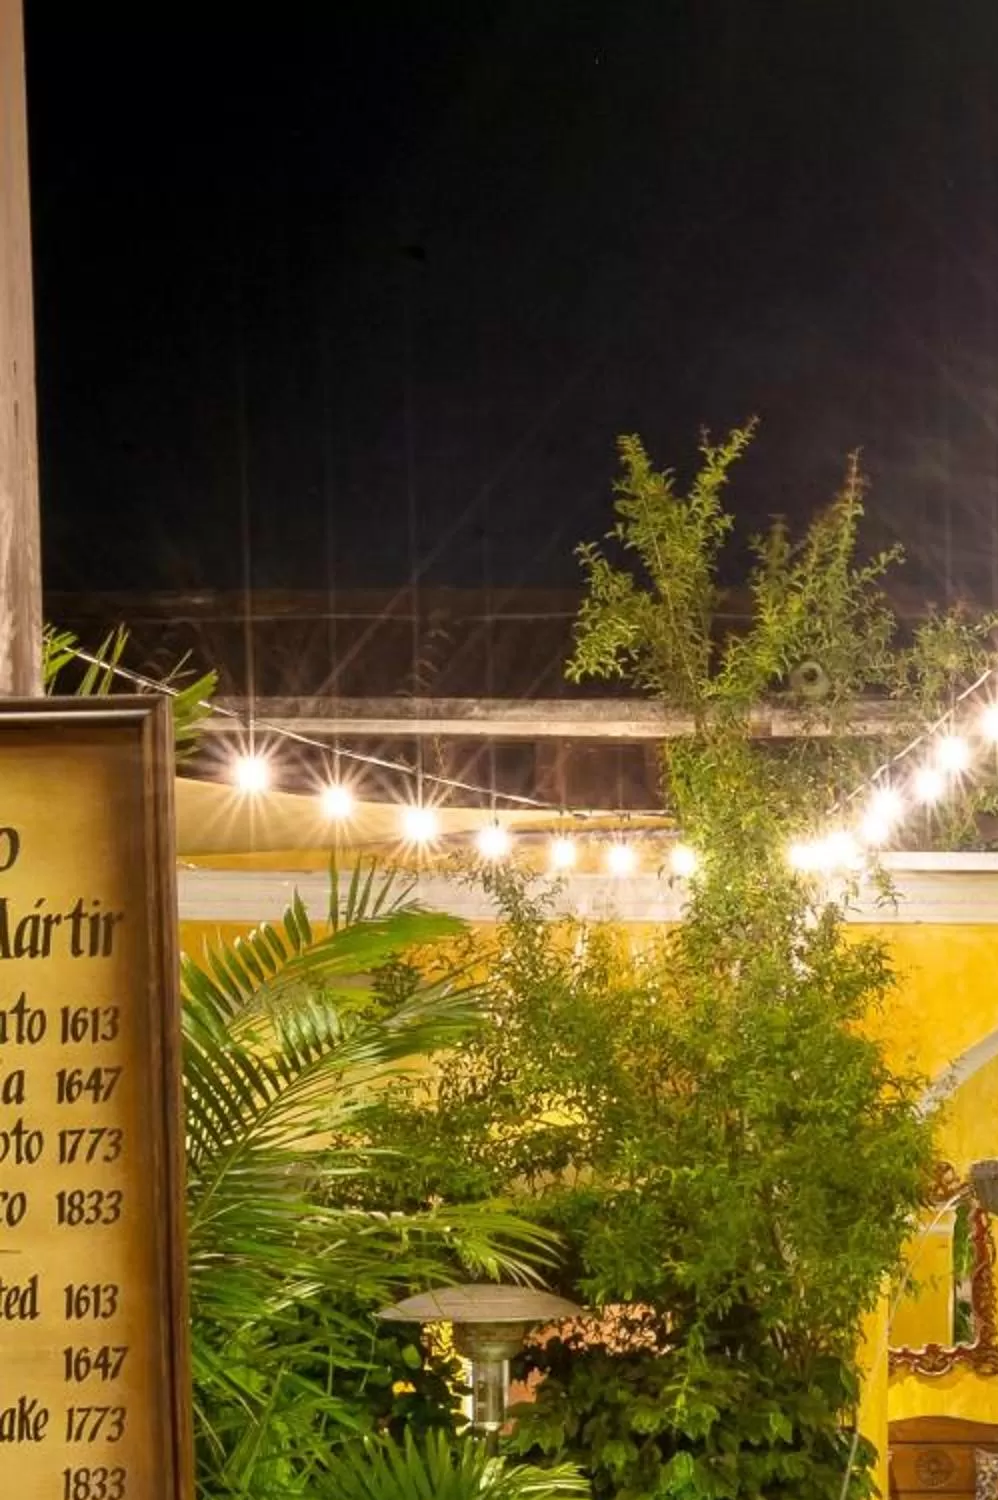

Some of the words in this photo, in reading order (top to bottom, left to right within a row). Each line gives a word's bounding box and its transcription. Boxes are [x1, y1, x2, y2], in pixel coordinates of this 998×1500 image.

[60, 1005, 120, 1044] 1613
[56, 1065, 123, 1104] 1647
[58, 1127, 124, 1164] 1773
[0, 1189, 27, 1227] o
[56, 1188, 123, 1226] 1833
[64, 1283, 119, 1320] 1613
[63, 1345, 128, 1382] 1647
[65, 1406, 127, 1443] 1773
